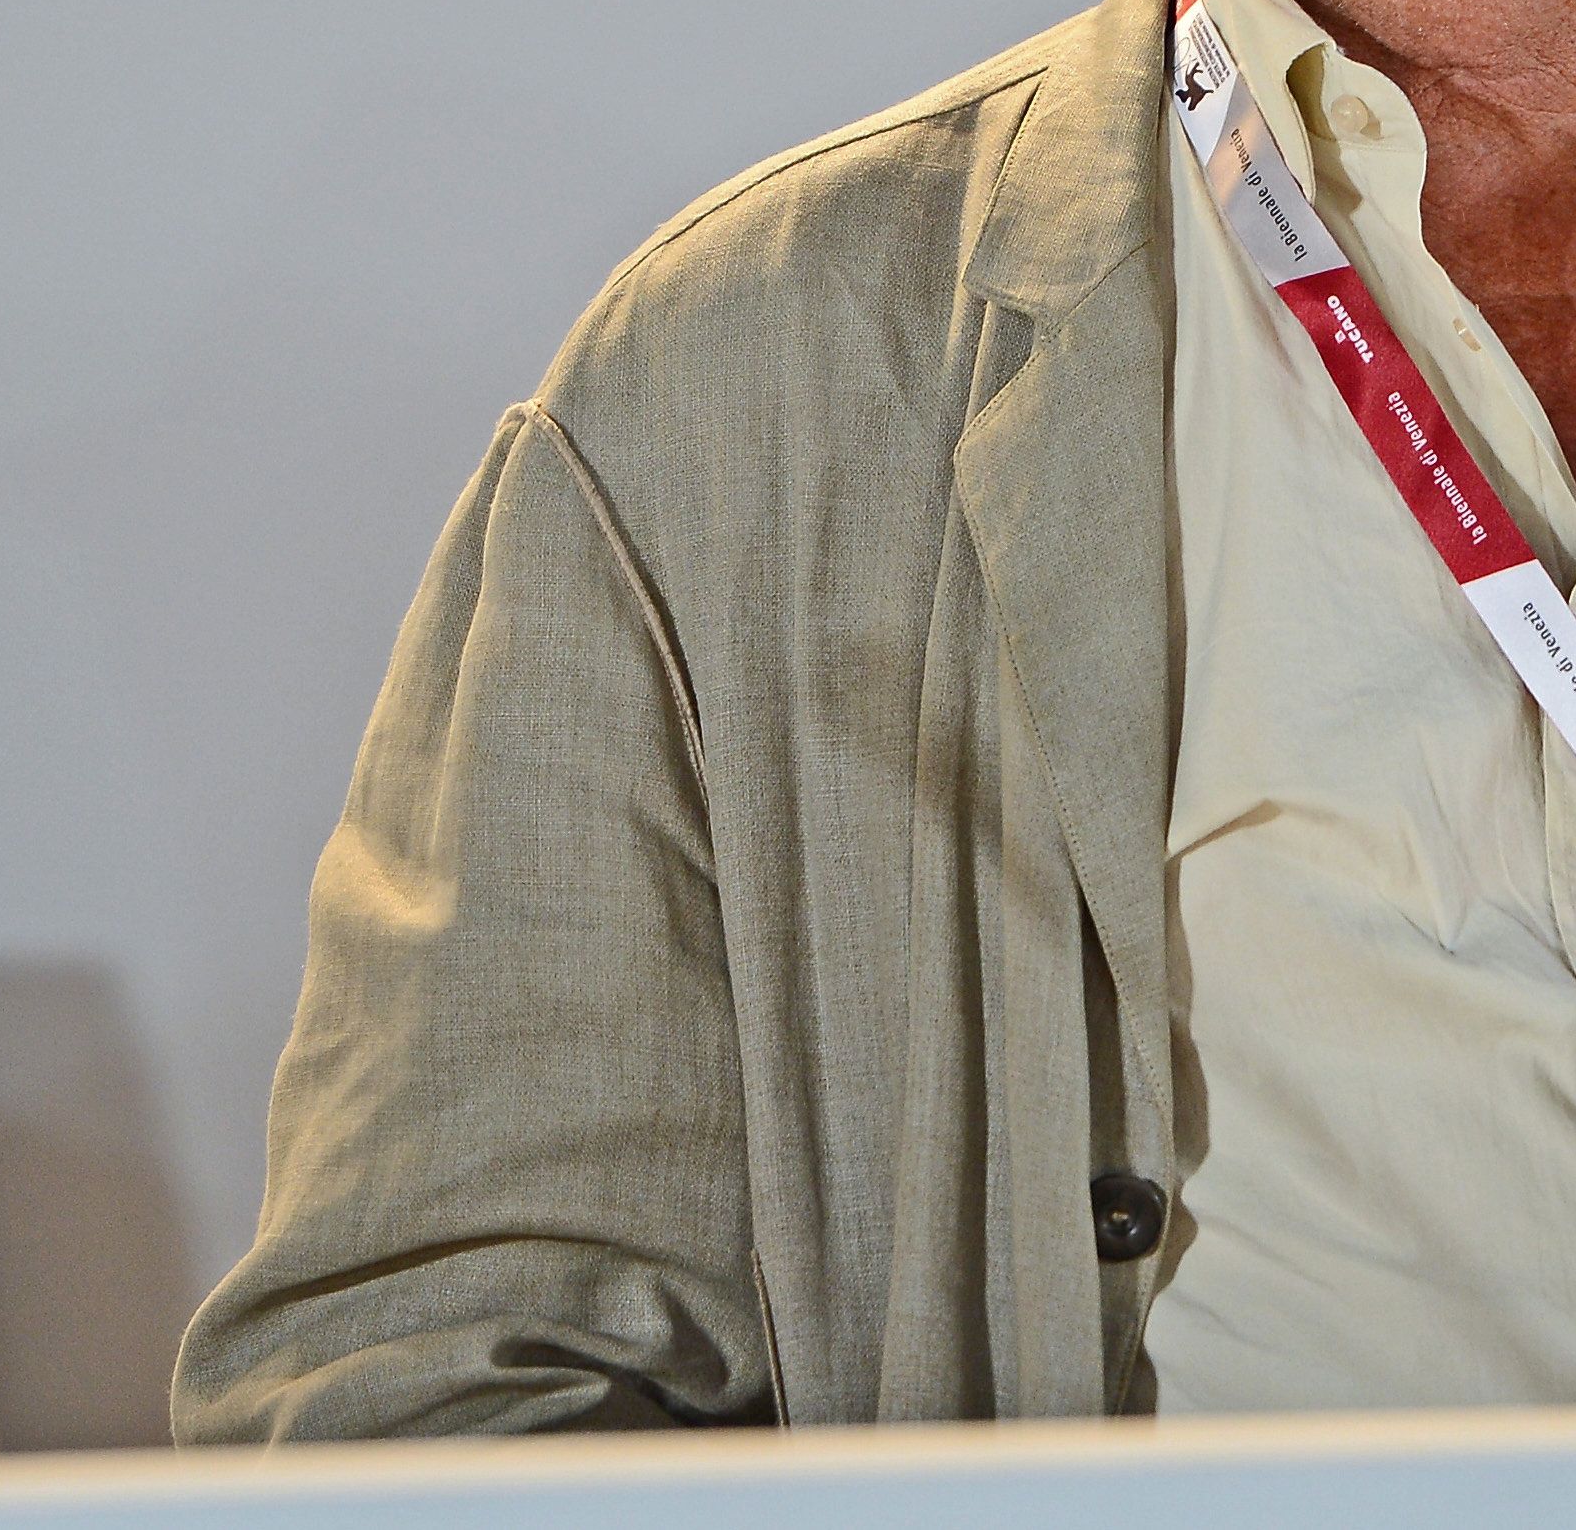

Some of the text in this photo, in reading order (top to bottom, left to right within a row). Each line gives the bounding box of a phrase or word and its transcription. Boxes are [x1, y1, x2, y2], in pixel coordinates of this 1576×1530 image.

[1230, 128, 1307, 262] la Biennale di Venezia
[1327, 295, 1374, 363] TUCANO
[1388, 391, 1488, 545] la Biennale di Venezia
[1523, 602, 1561, 658] Venezia
[1556, 657, 1573, 672] di
